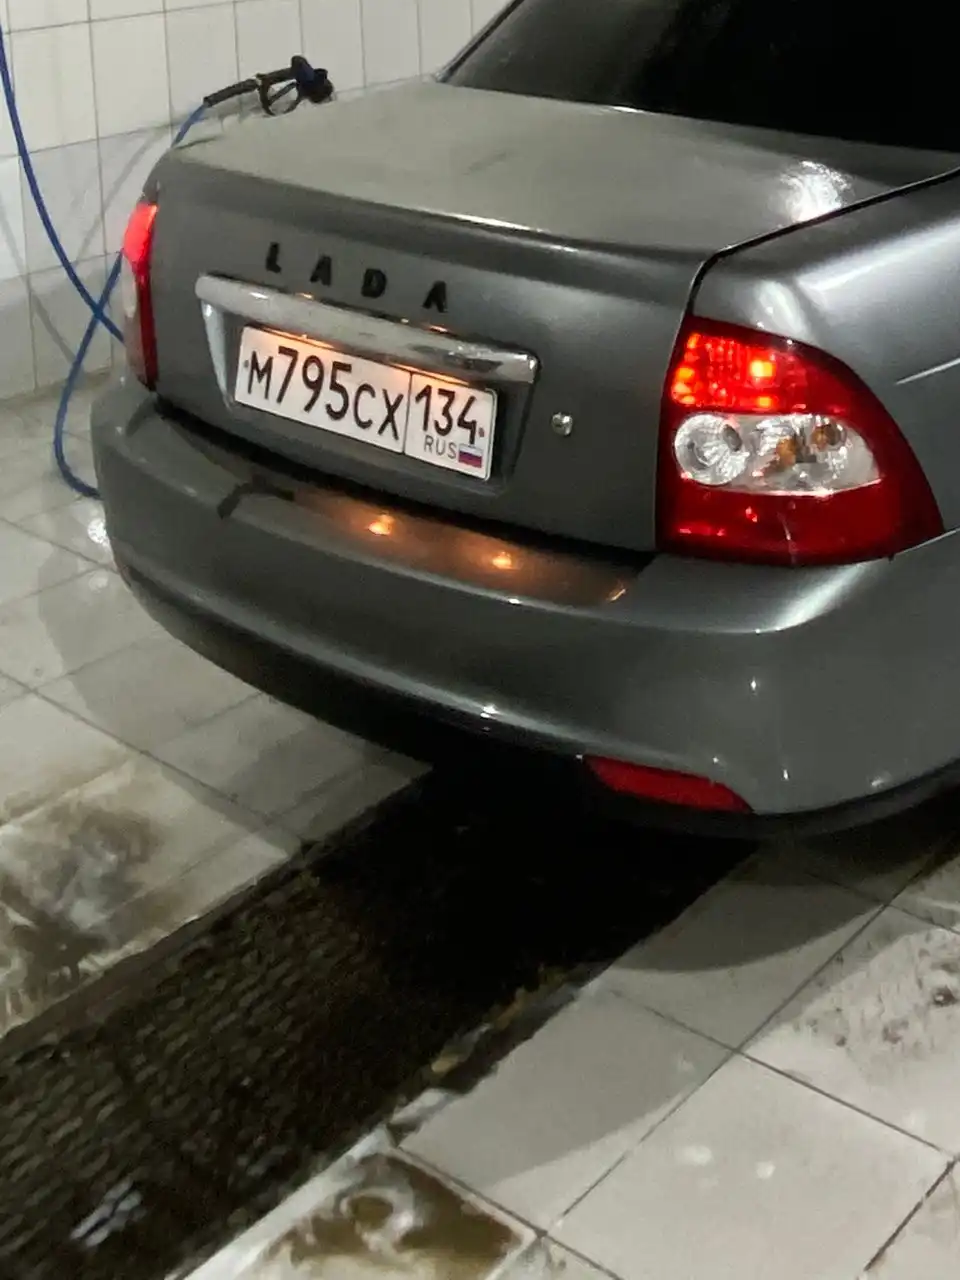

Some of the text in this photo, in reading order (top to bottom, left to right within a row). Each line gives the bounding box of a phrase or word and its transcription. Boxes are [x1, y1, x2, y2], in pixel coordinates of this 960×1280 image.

[265, 241, 448, 313] LADA
[415, 384, 477, 445] 134
[423, 435, 458, 461] RUS
